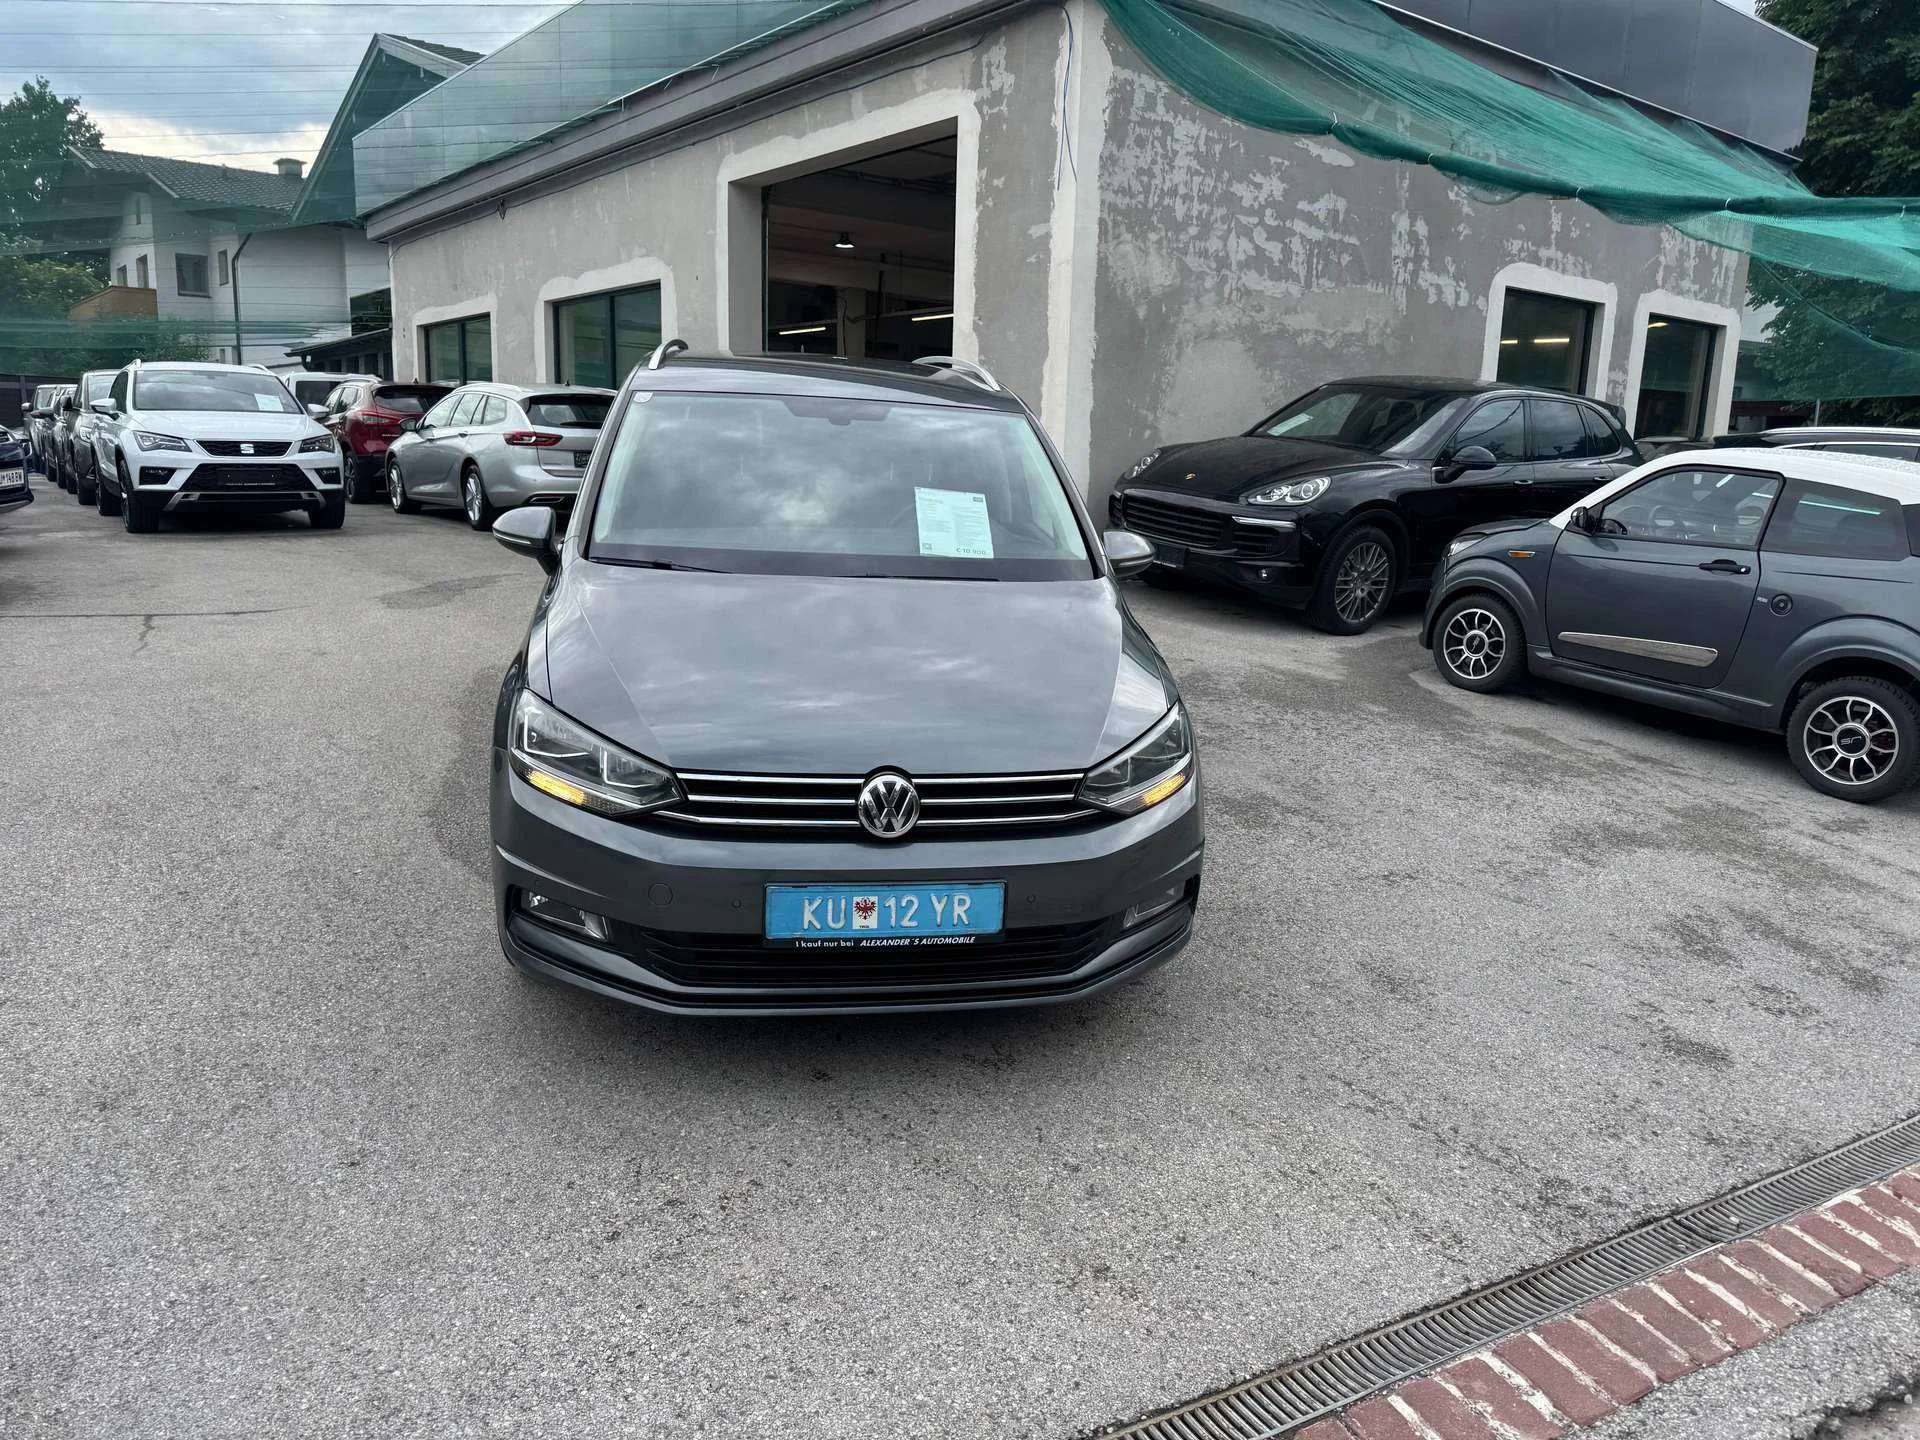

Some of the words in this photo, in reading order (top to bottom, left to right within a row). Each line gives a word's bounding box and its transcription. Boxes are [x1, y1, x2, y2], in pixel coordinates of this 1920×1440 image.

[803, 895, 846, 930] KU
[884, 894, 919, 928] 12
[930, 893, 971, 926] YR
[801, 939, 822, 948] kauf
[840, 939, 854, 947] bei
[920, 936, 976, 945] AUTOMOBILE
